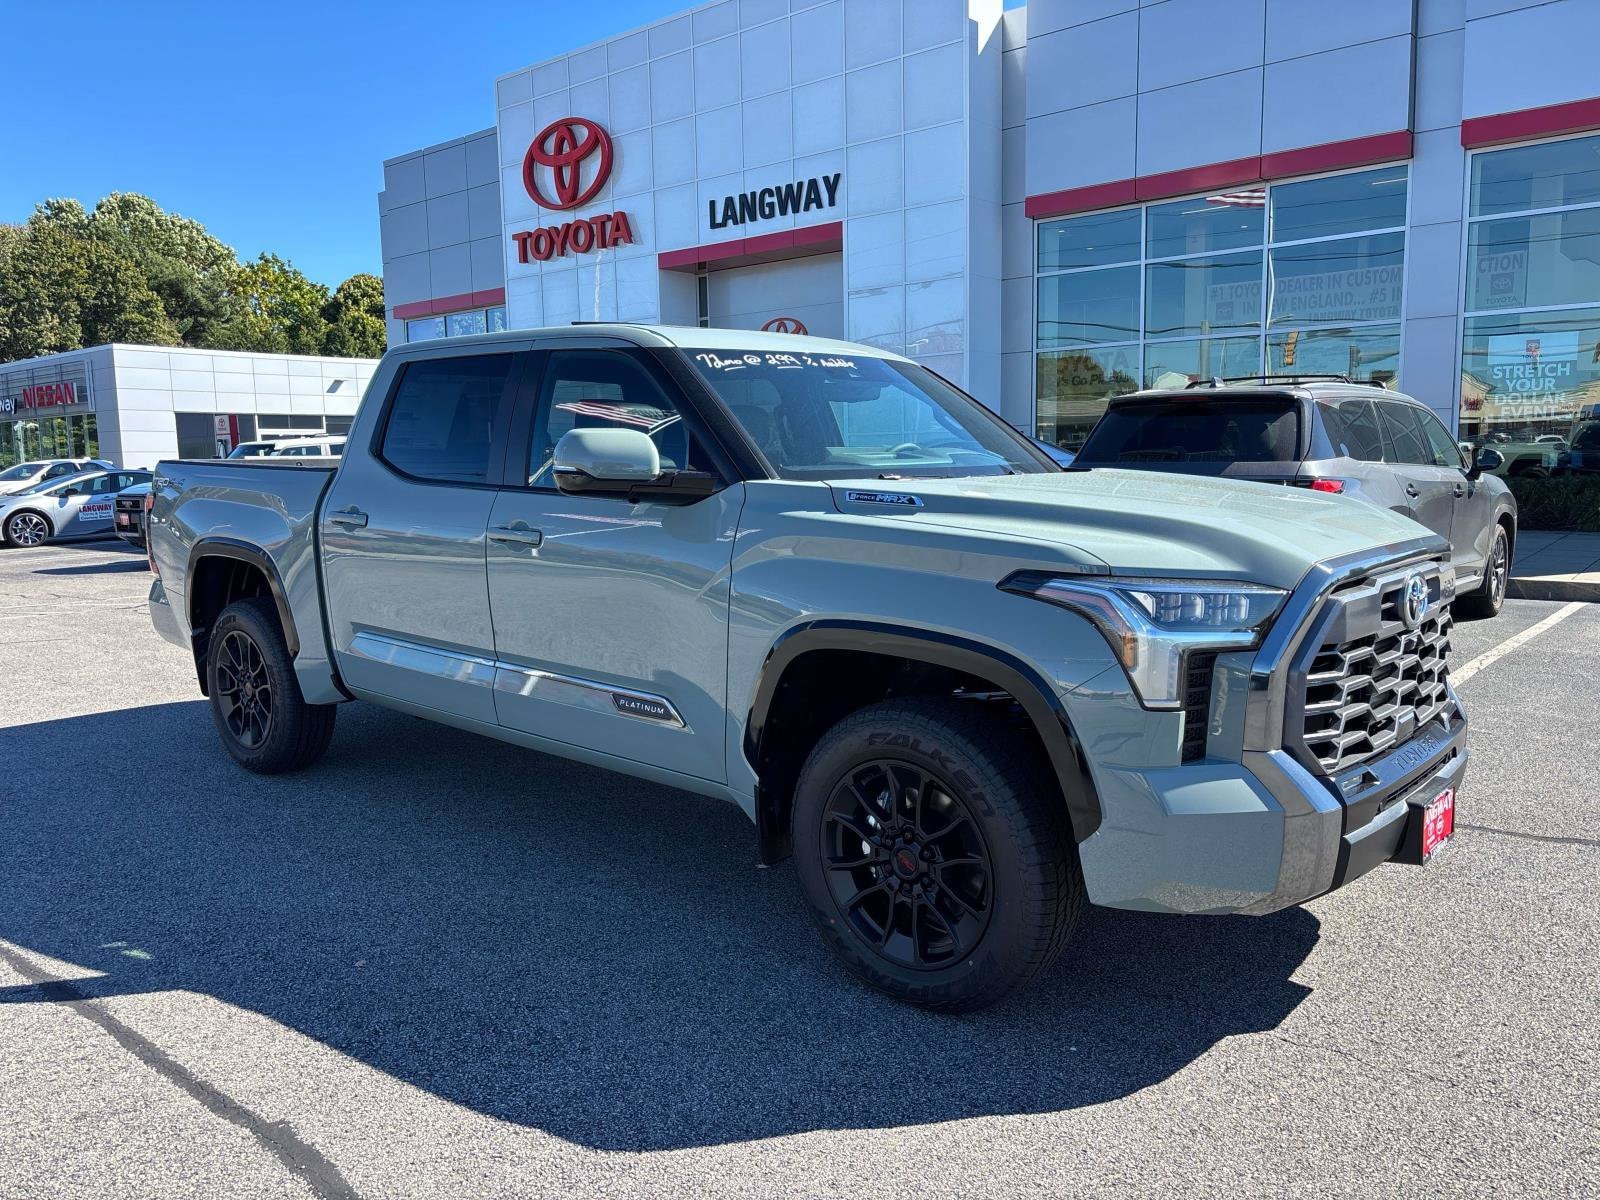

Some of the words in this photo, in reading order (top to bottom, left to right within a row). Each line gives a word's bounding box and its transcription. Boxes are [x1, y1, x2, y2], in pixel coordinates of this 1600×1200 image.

[708, 172, 842, 230] LANGWAY
[511, 211, 634, 264] TOYOTA
[1229, 283, 1265, 300] TOYO
[1278, 277, 1325, 296] DEALER
[1327, 274, 1342, 290] IN
[1492, 361, 1571, 379] STRETCH
[1506, 377, 1556, 393] YOUR
[22, 381, 78, 409] NISSAN
[1494, 391, 1567, 406] DOLLAR
[1501, 404, 1559, 420] EVENT
[876, 493, 910, 504] MAX
[78, 503, 112, 513] LANGWAY
[620, 699, 665, 714] PLATINUM
